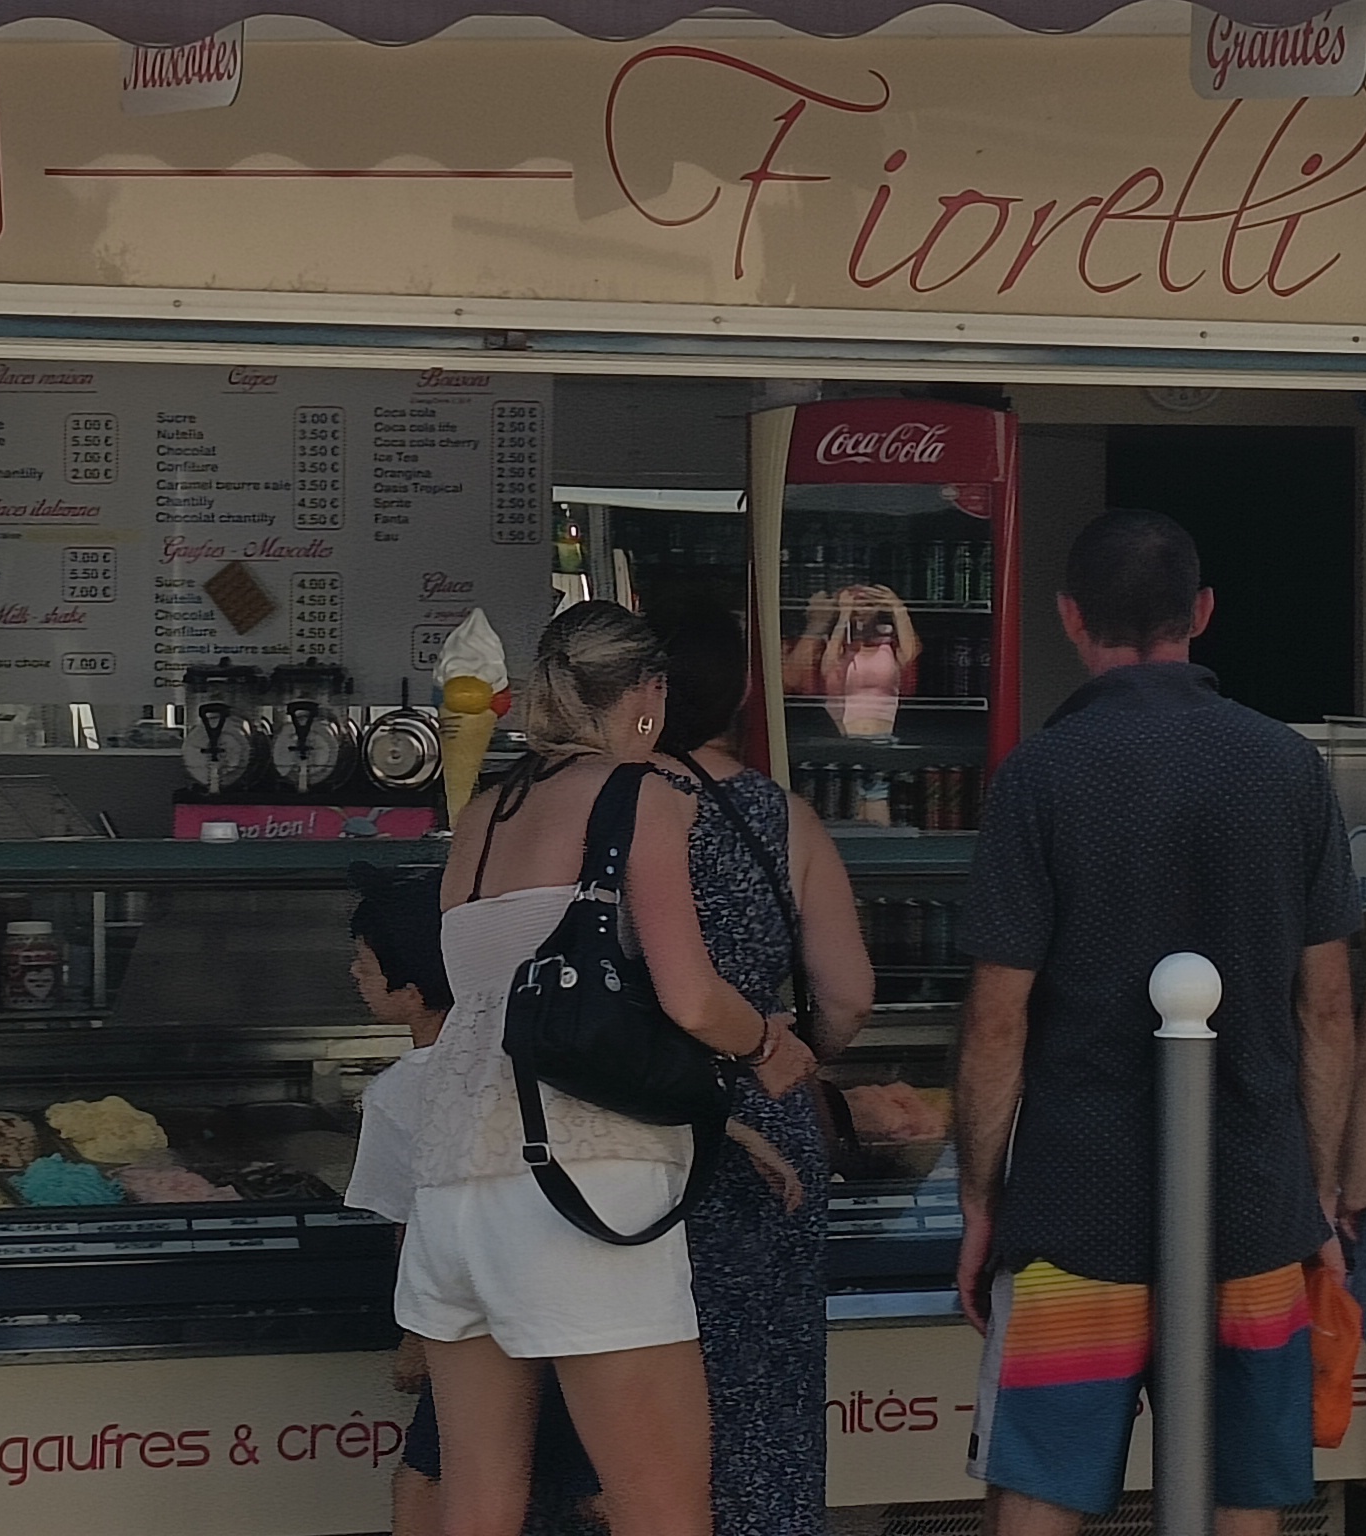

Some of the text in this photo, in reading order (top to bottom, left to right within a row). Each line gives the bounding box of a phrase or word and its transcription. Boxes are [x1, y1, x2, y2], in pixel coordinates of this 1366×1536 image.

[1205, 15, 1346, 92] Granités
[229, 1427, 261, 1465] &
[275, 1412, 406, 1470] crêp
